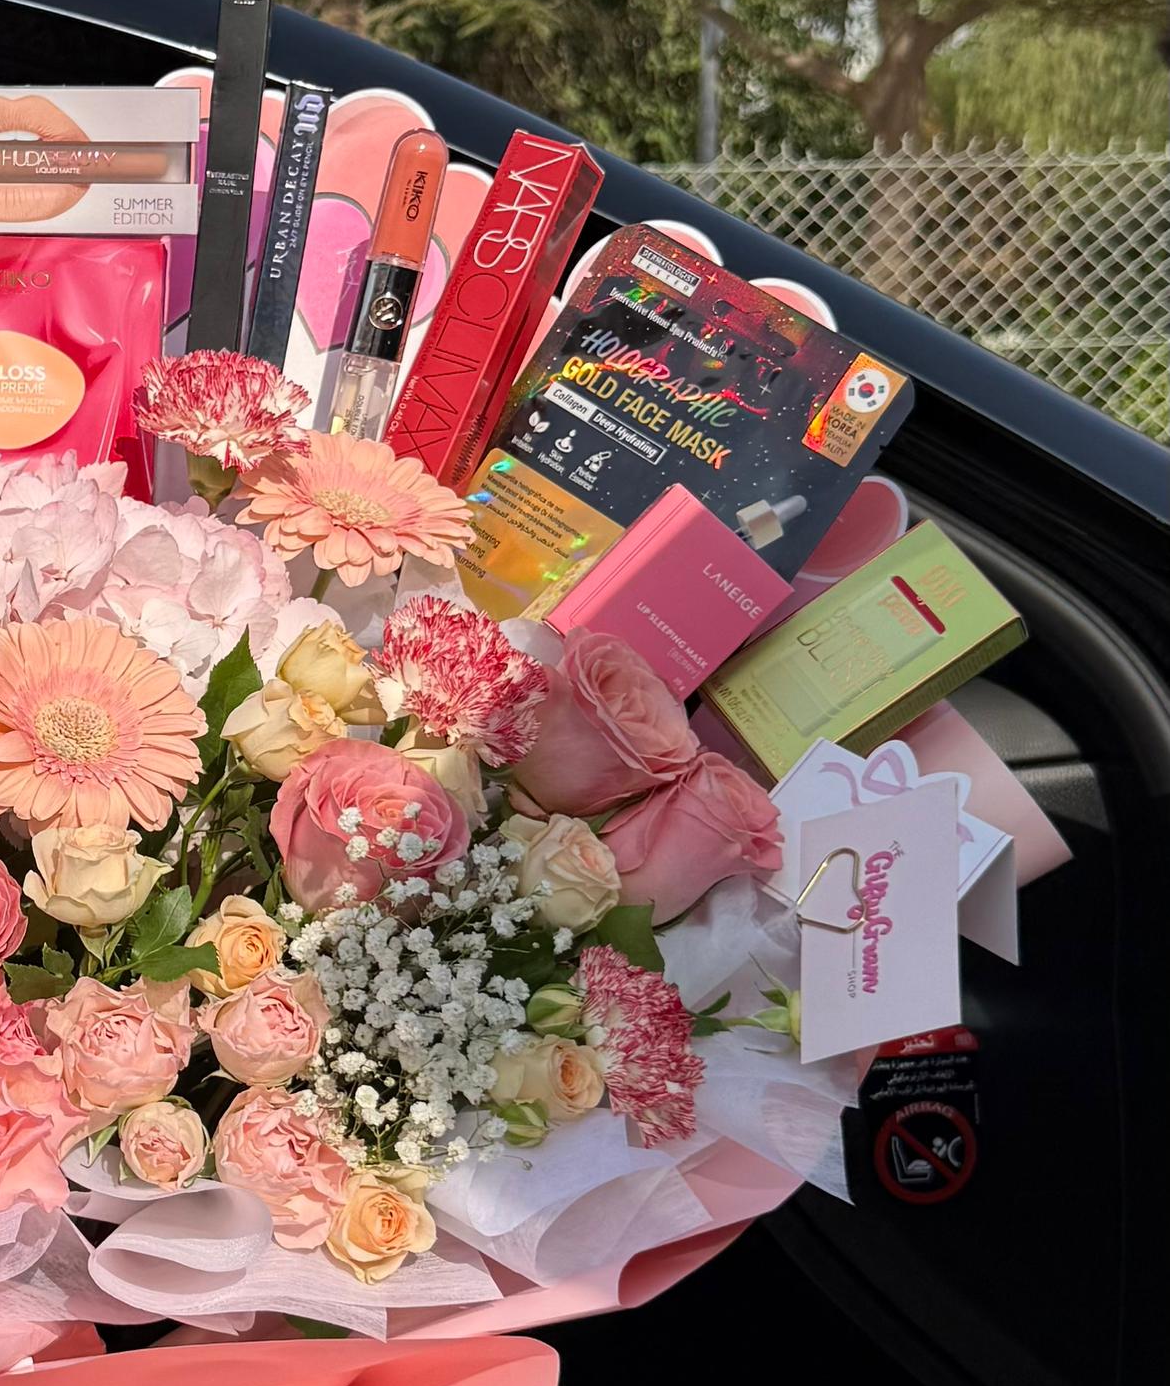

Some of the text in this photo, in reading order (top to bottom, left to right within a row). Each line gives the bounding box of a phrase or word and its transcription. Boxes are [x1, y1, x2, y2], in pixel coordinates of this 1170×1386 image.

[113, 198, 173, 211] SUMMER
[113, 213, 174, 225] EDITION
[270, 140, 305, 279] URBAN DECAY
[406, 170, 428, 222] KIKO
[474, 140, 574, 274] NARS
[396, 272, 510, 474] CLIMAX
[553, 389, 658, 459] Collagen Deep Hydrating
[561, 356, 731, 470] GOLD FACE MASK
[569, 473, 594, 492] Essence
[576, 466, 597, 483] Perfect
[703, 563, 763, 619] LANEIGE
[637, 602, 708, 669] LIP SLEEPING MASK
[889, 840, 905, 859] THE
[847, 970, 856, 998] SHOP
[895, 1100, 954, 1124] AIRBAG
